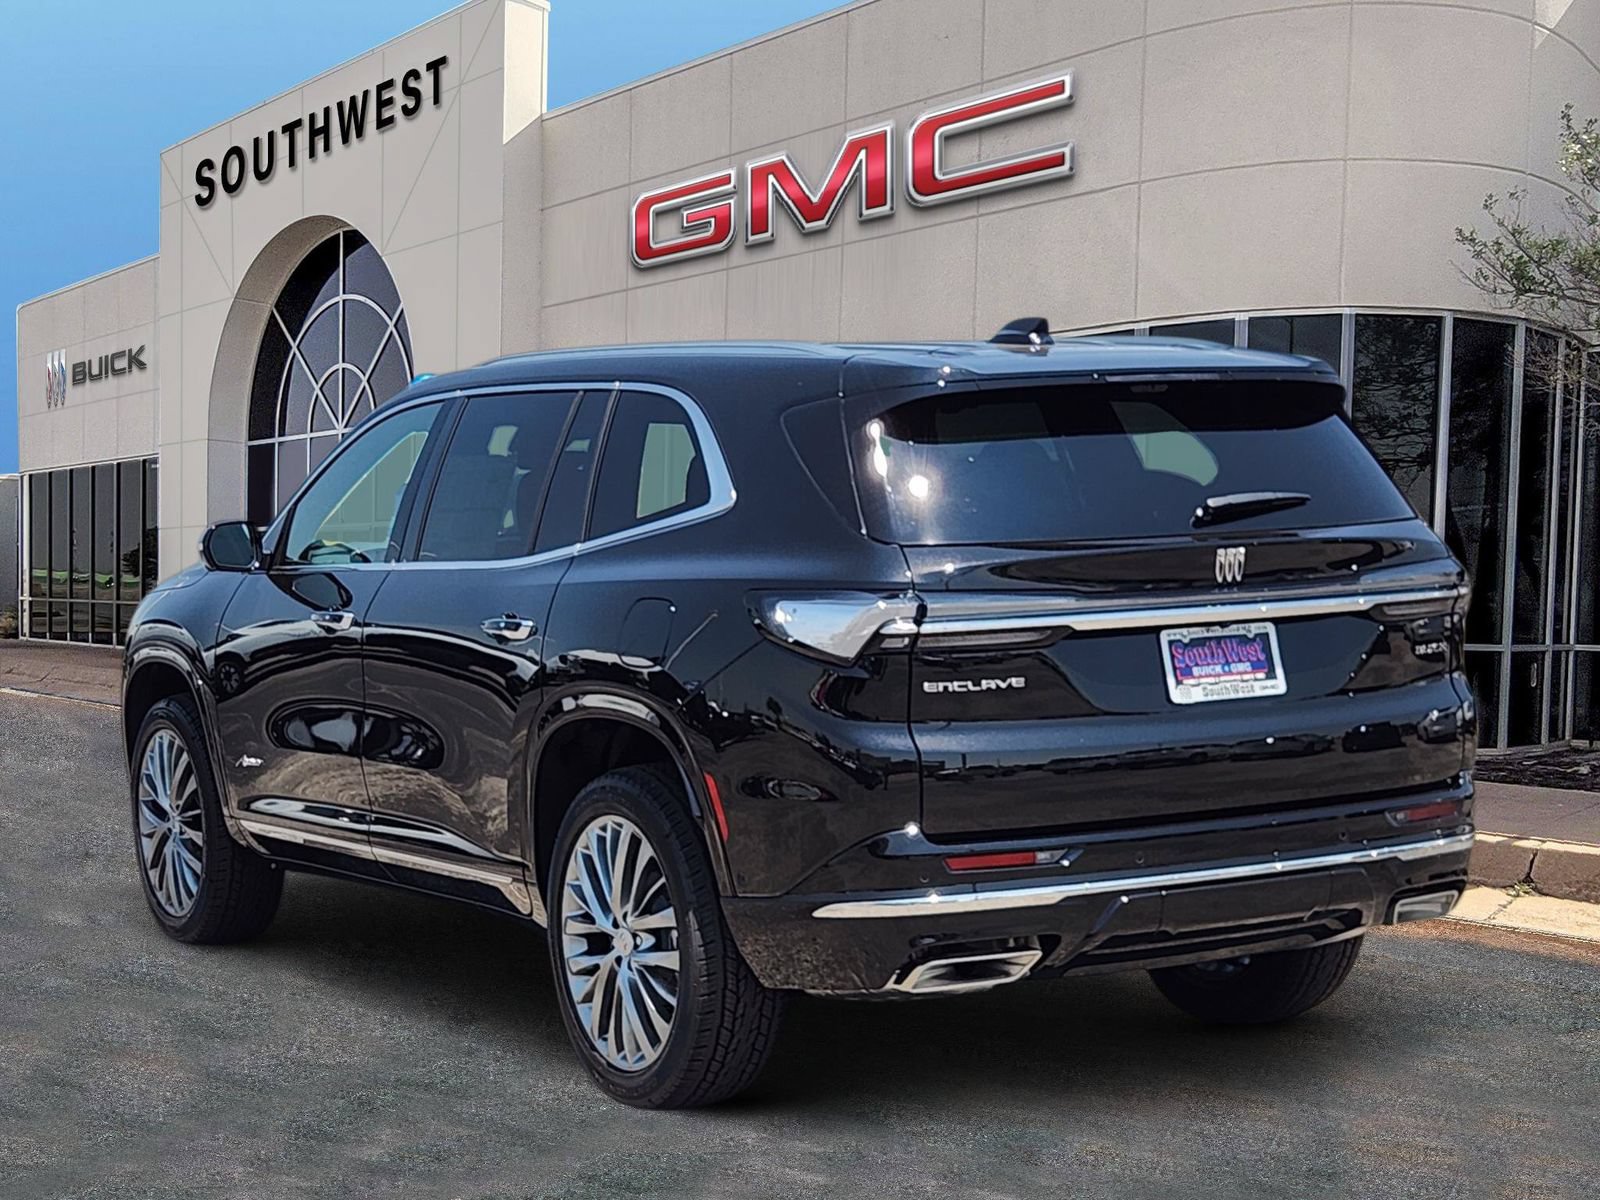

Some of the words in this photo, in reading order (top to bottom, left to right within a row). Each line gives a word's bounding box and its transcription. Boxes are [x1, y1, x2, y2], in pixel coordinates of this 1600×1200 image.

[195, 55, 447, 207] SOUTHWEST
[630, 69, 1076, 268] GMC
[72, 344, 147, 386] BUICK
[923, 677, 1025, 692] ENCLAVE
